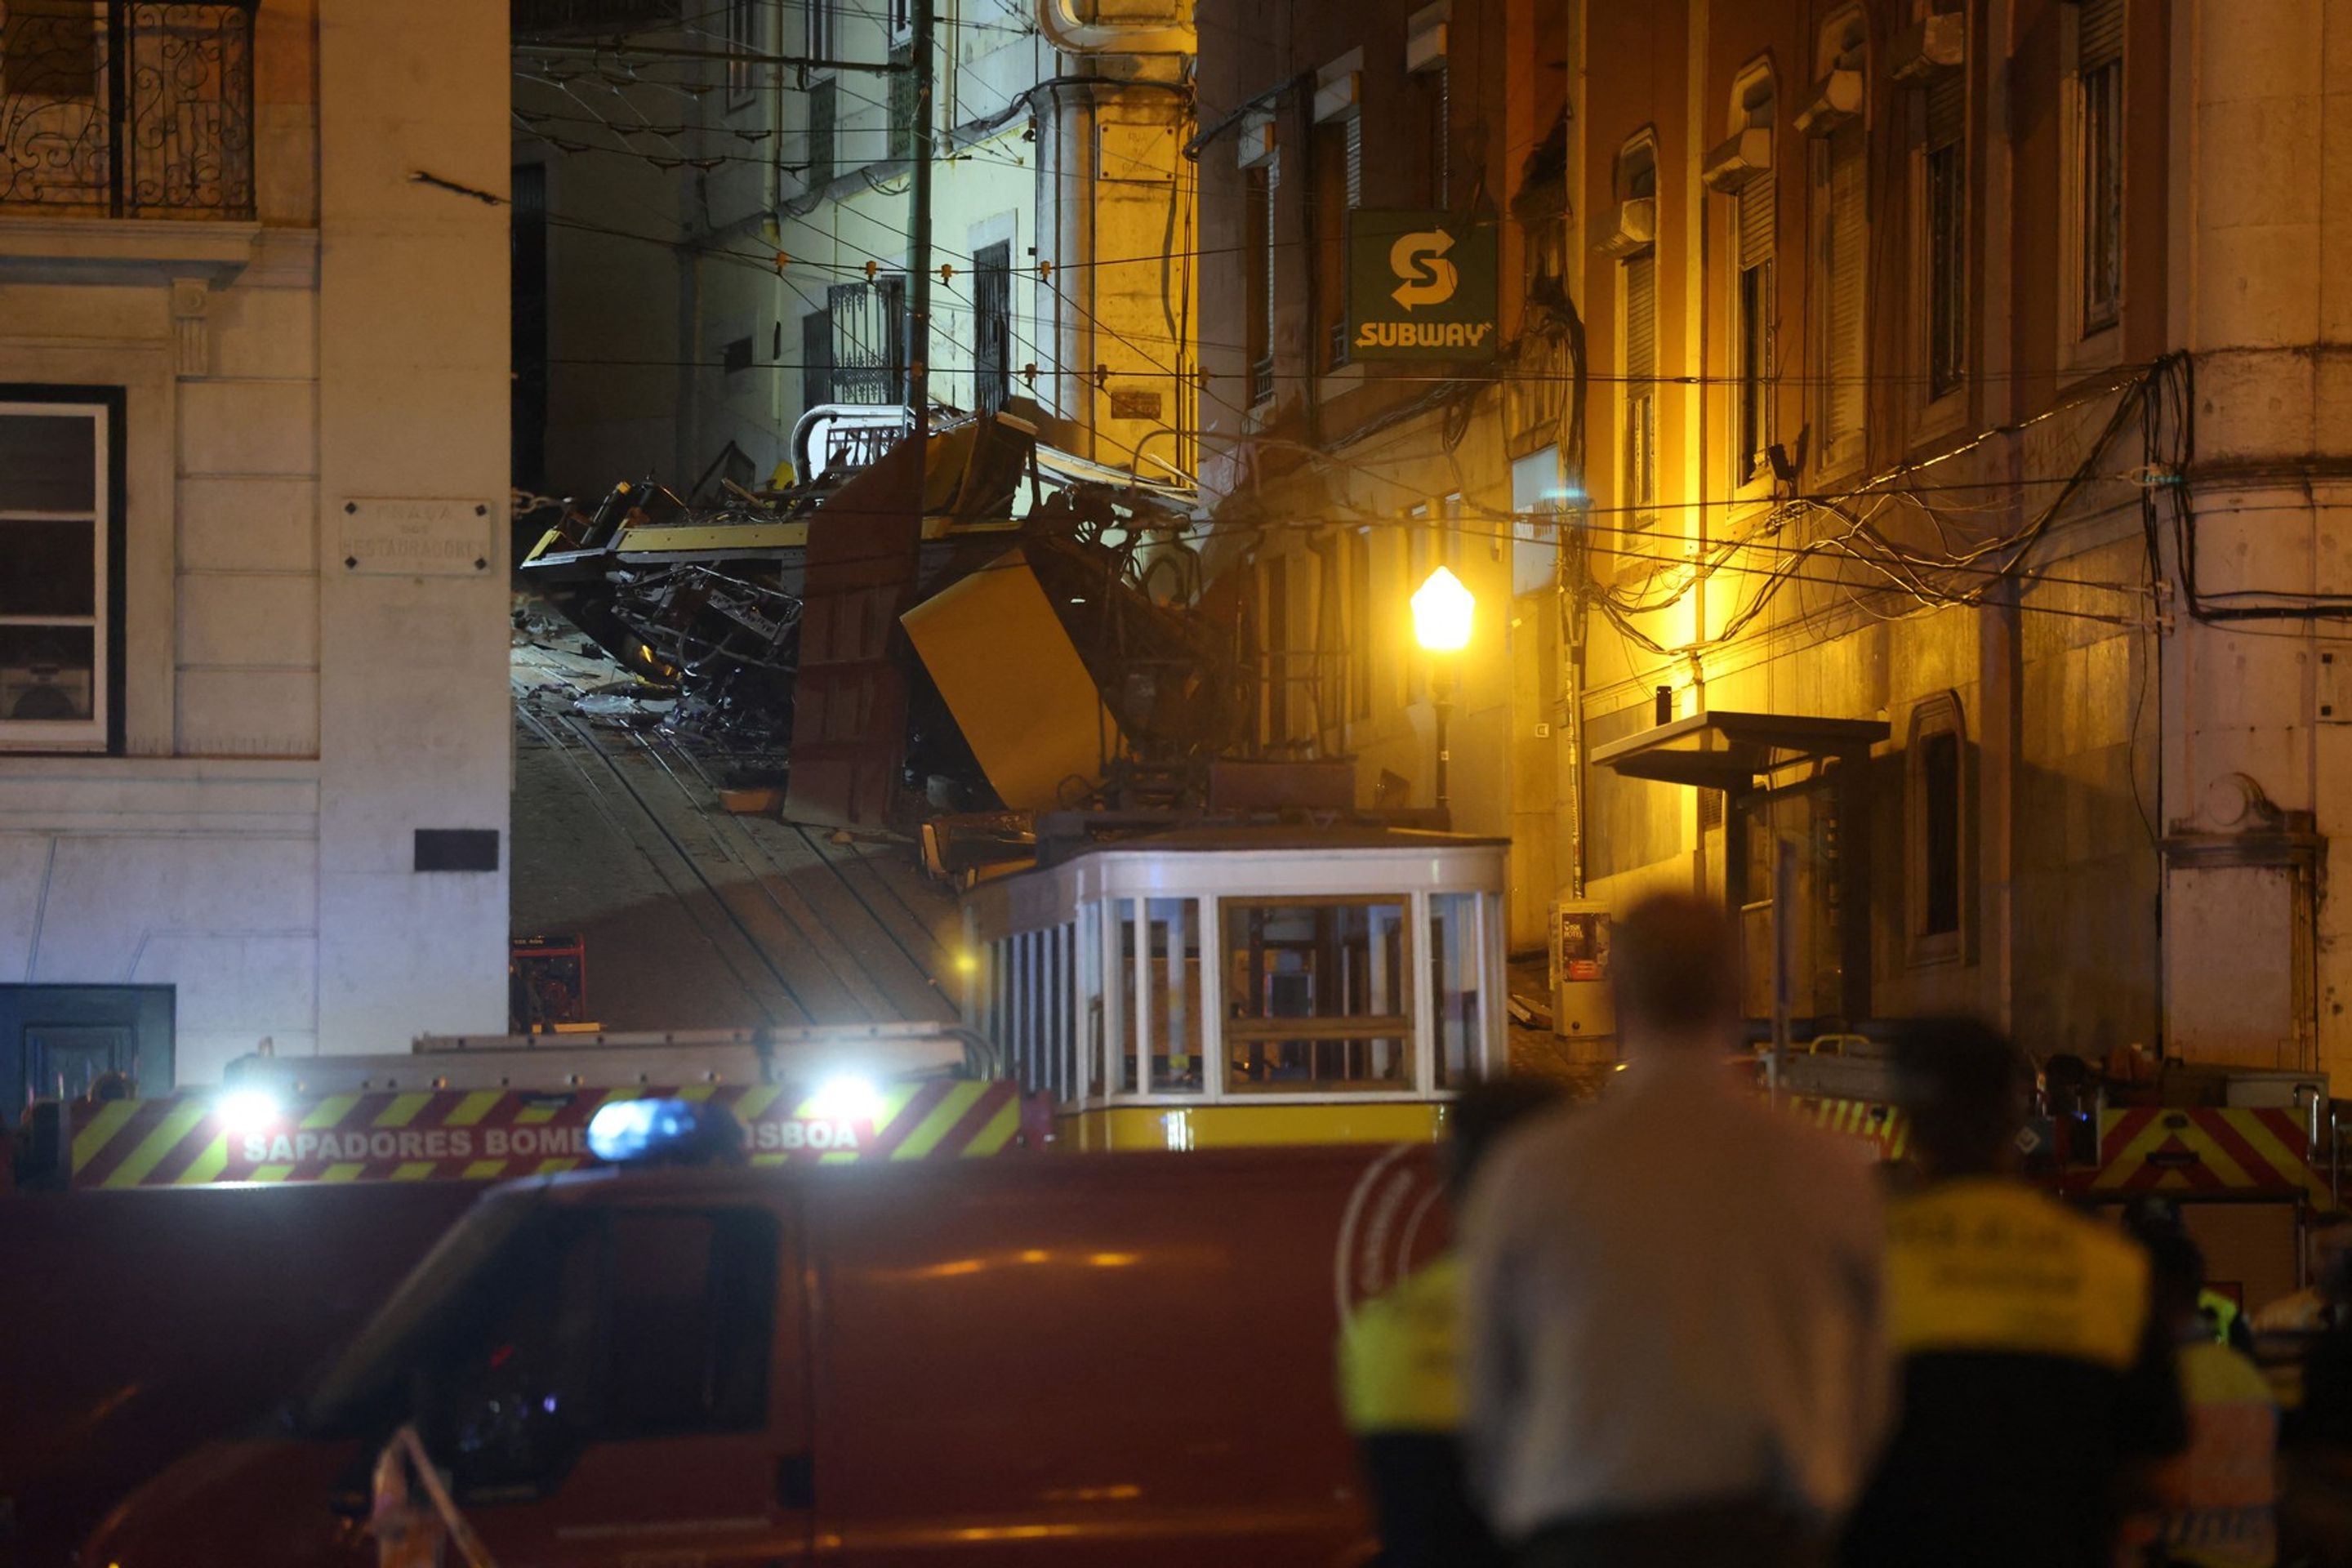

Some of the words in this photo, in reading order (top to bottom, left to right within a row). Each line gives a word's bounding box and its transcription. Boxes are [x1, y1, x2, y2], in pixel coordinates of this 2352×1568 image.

[1355, 323, 1492, 348] SUBWAY
[243, 1129, 472, 1162] SAPADORES
[746, 1119, 858, 1150] ISBOA
